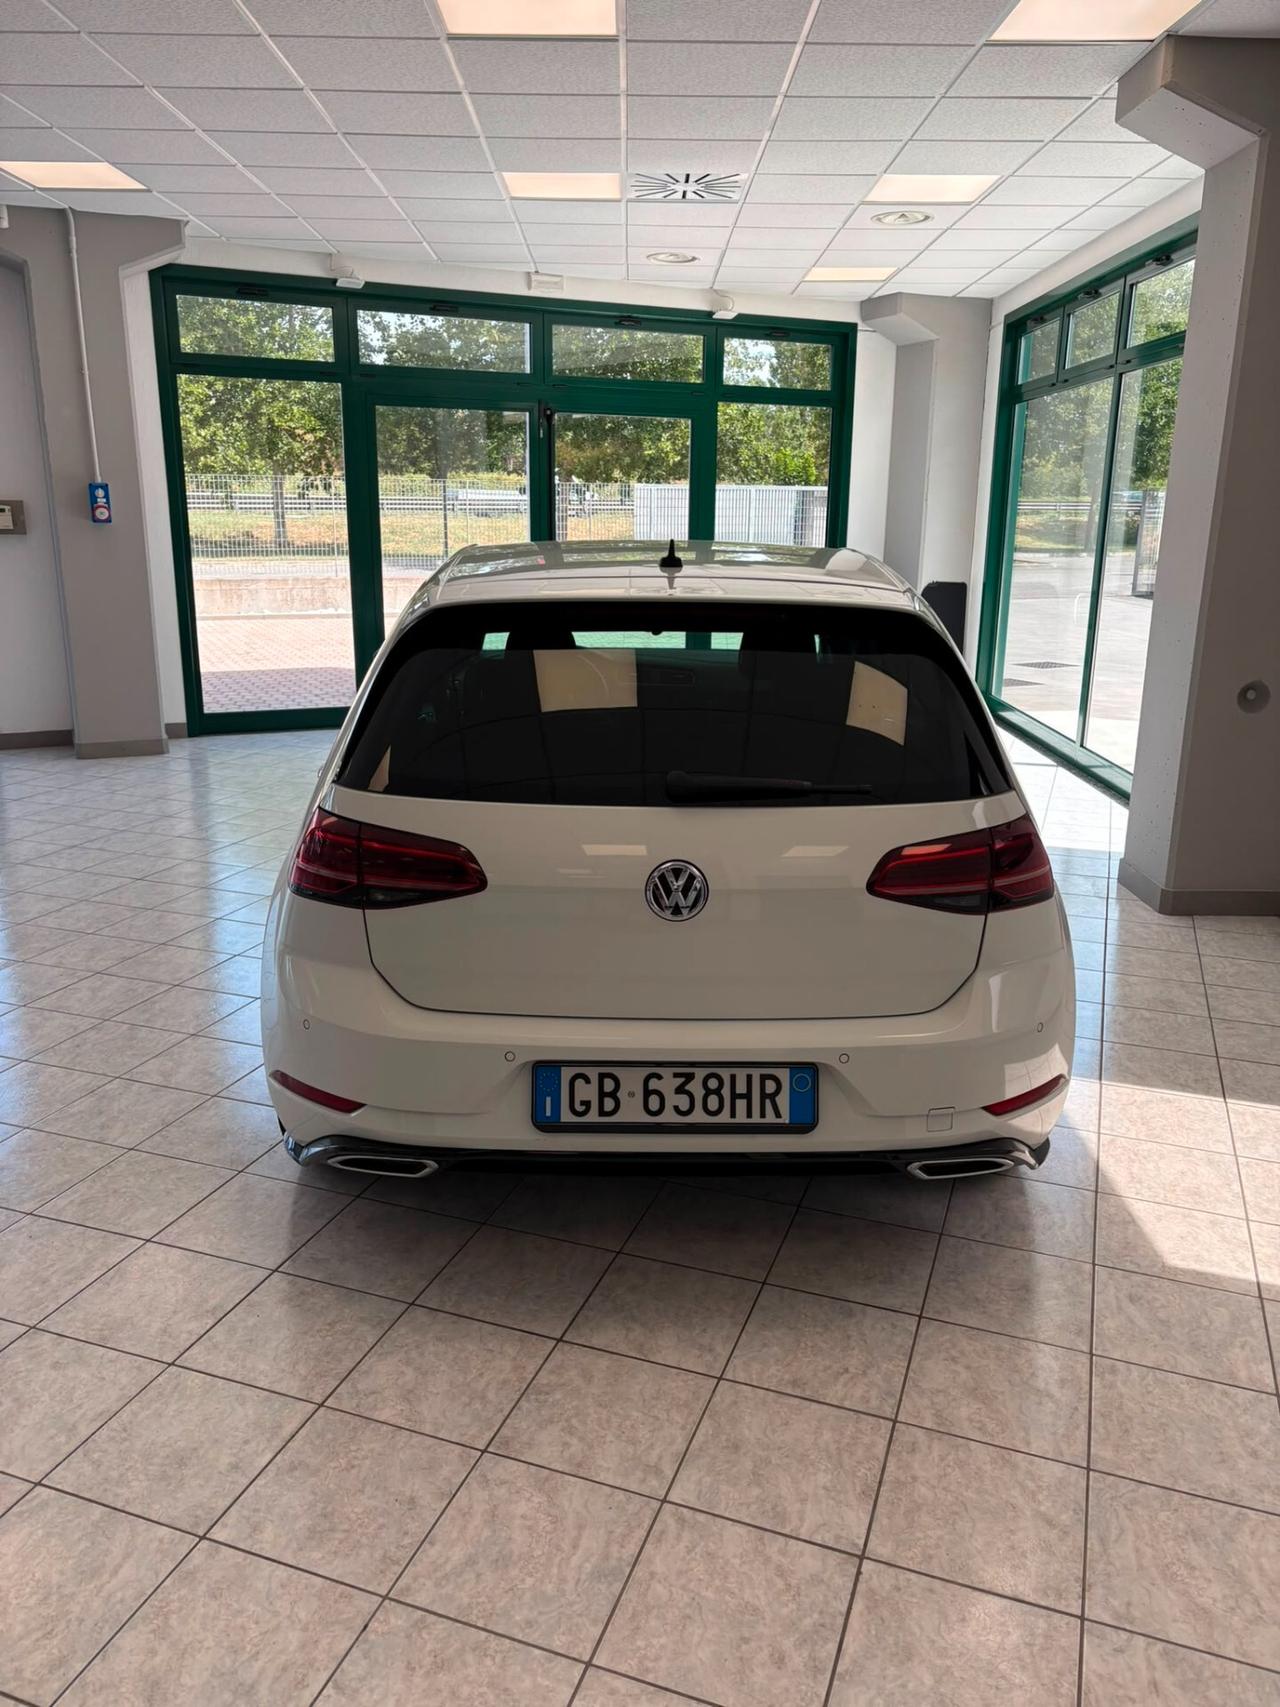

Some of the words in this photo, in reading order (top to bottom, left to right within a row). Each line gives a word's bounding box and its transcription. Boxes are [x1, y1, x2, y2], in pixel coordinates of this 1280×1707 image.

[648, 861, 704, 918] VW
[568, 1072, 621, 1118] GB
[642, 1072, 783, 1119] 638HR
